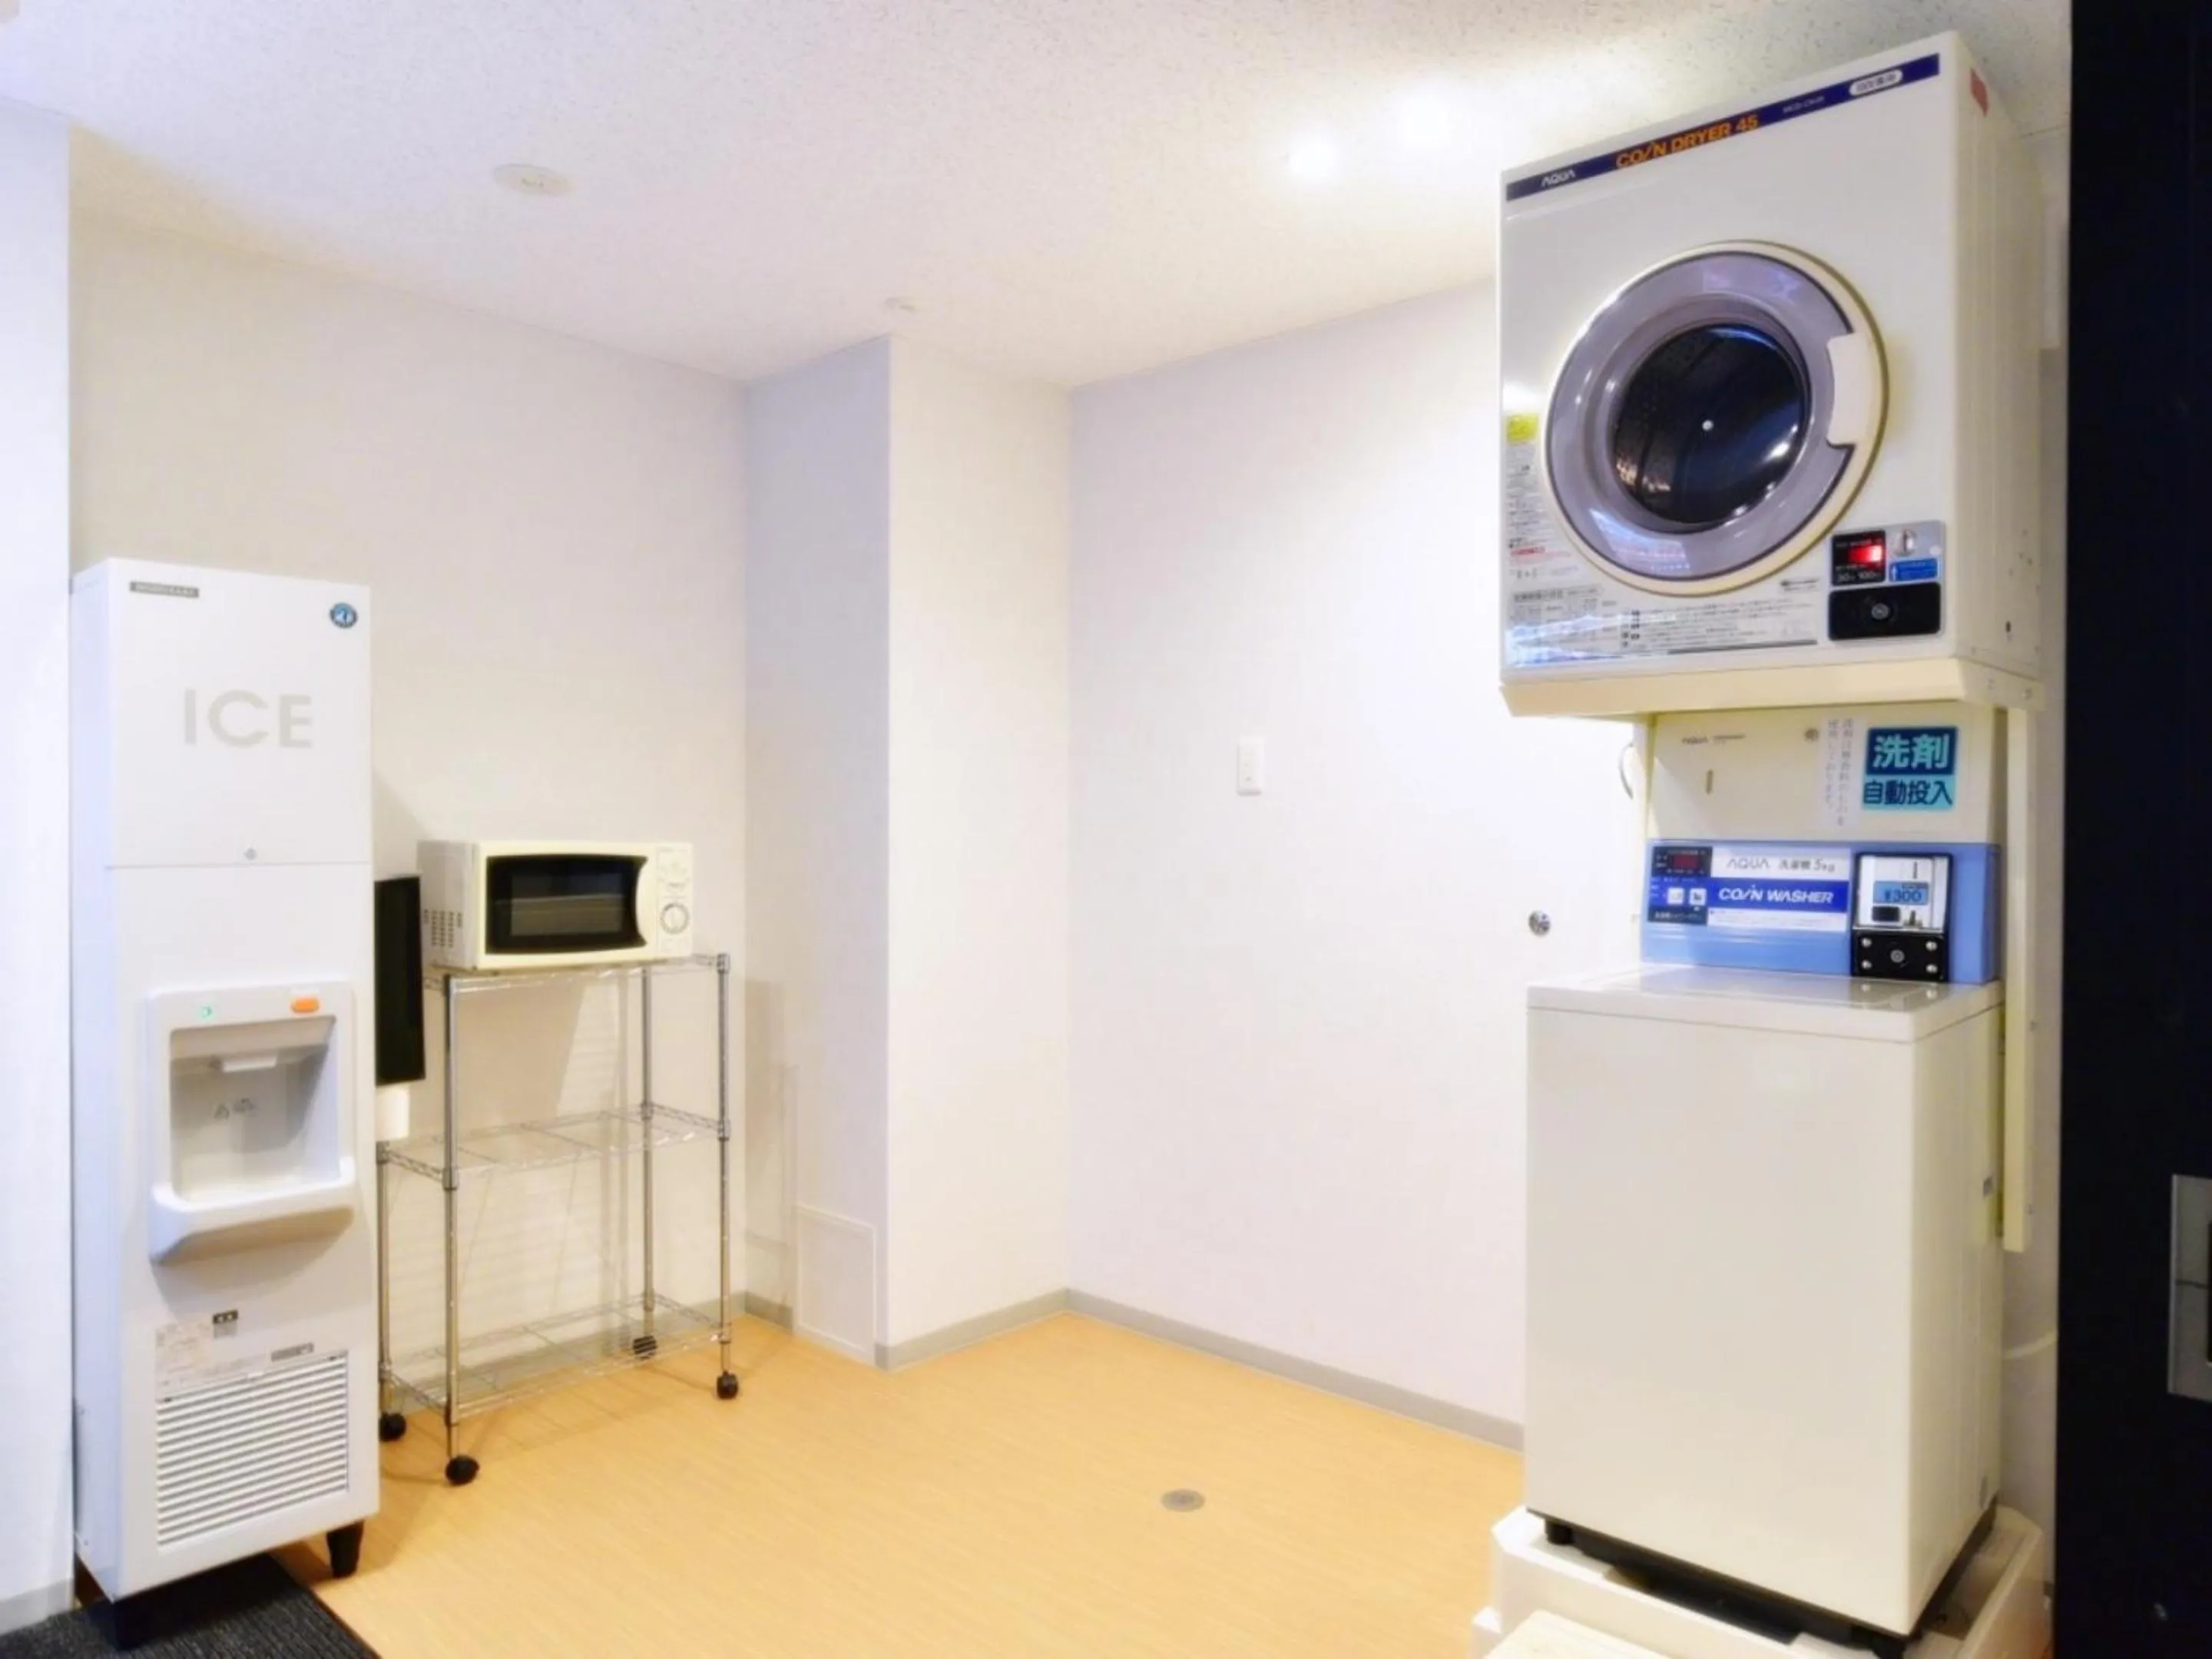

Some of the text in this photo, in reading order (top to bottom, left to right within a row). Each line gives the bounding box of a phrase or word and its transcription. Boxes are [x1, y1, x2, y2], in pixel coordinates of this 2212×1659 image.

[1671, 121, 1733, 153] DRYER
[1735, 114, 1760, 132] 45
[1541, 168, 1576, 187] AQUA
[184, 688, 312, 749] ICE
[1872, 733, 1951, 770] 洗剤
[1863, 778, 1953, 806] 自動投入
[1726, 856, 1770, 870] AQUA
[1767, 889, 1835, 905] WASHER
